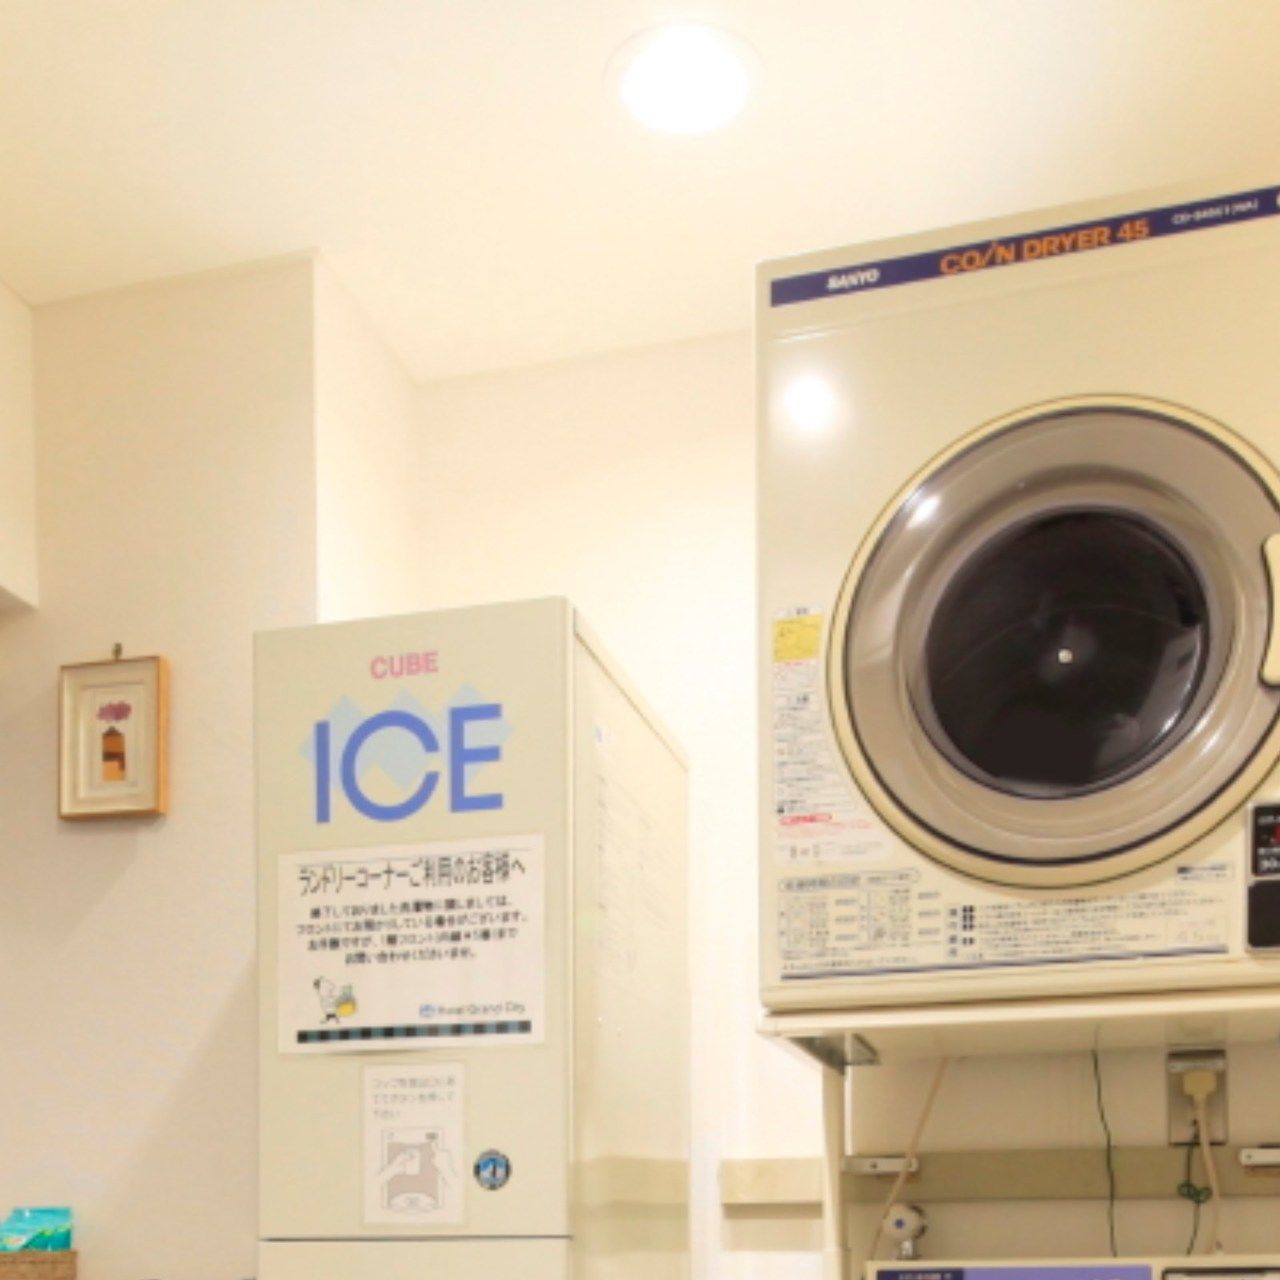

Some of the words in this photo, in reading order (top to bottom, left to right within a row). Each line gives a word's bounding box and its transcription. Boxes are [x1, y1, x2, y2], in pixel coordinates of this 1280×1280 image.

[827, 269, 880, 291] SANYO
[1023, 224, 1112, 261] DRYER
[1117, 217, 1151, 241] 45
[369, 650, 439, 680] CUBE
[315, 703, 504, 824] ICE
